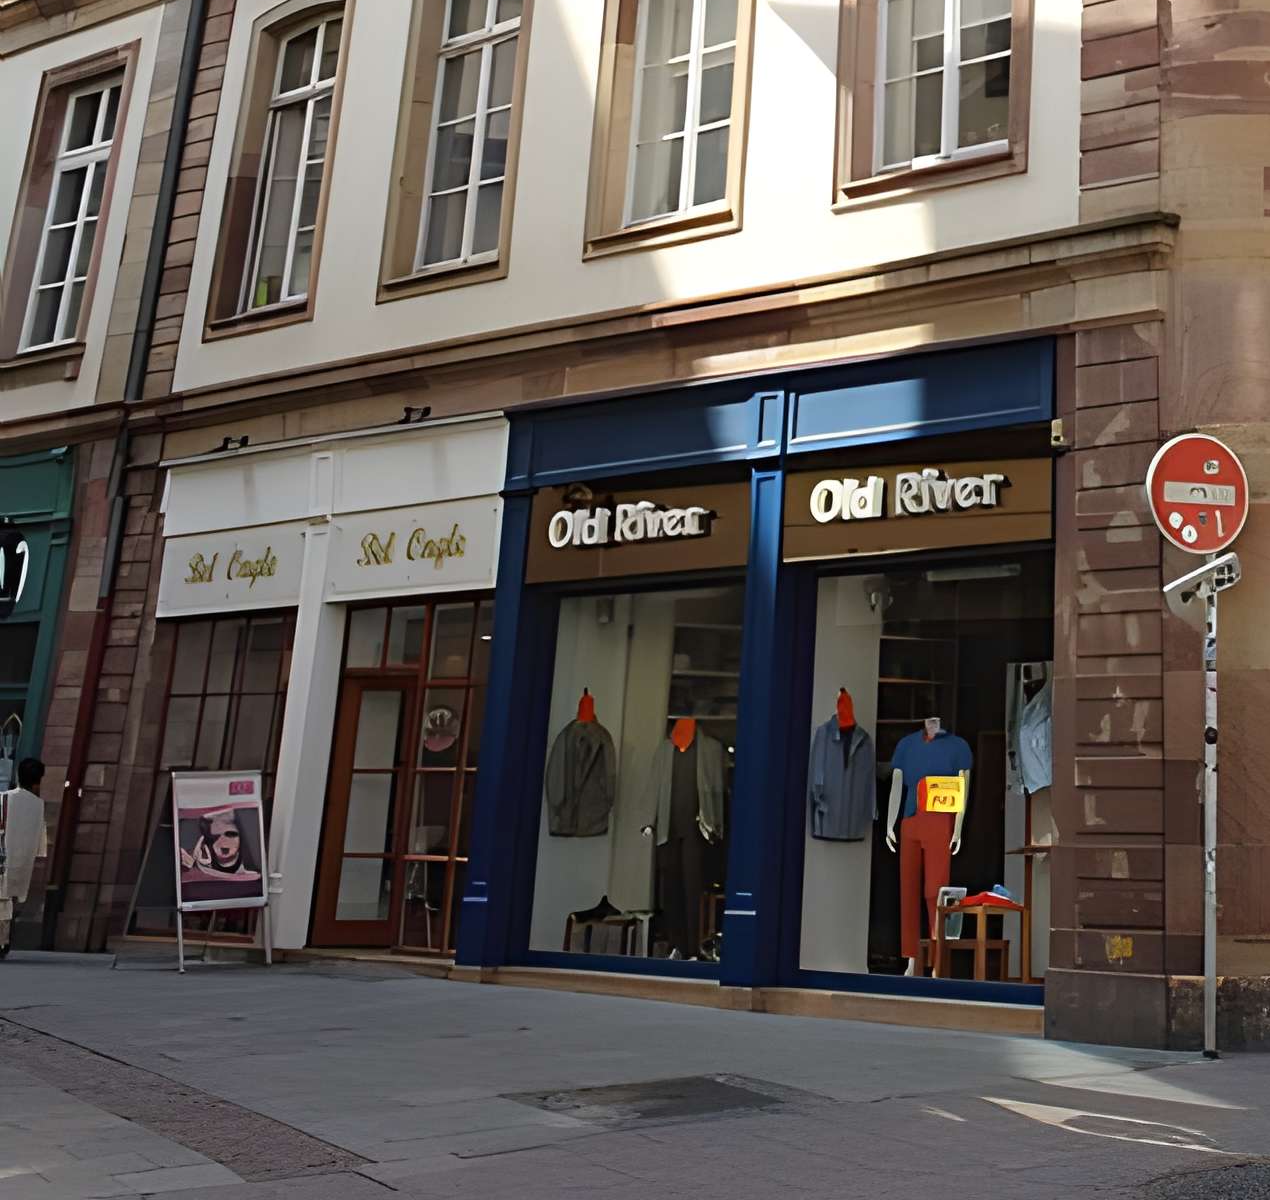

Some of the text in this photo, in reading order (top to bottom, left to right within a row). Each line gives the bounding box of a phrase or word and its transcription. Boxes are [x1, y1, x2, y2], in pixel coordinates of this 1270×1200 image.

[809, 467, 1005, 524] Old River
[548, 500, 712, 548] Old River
